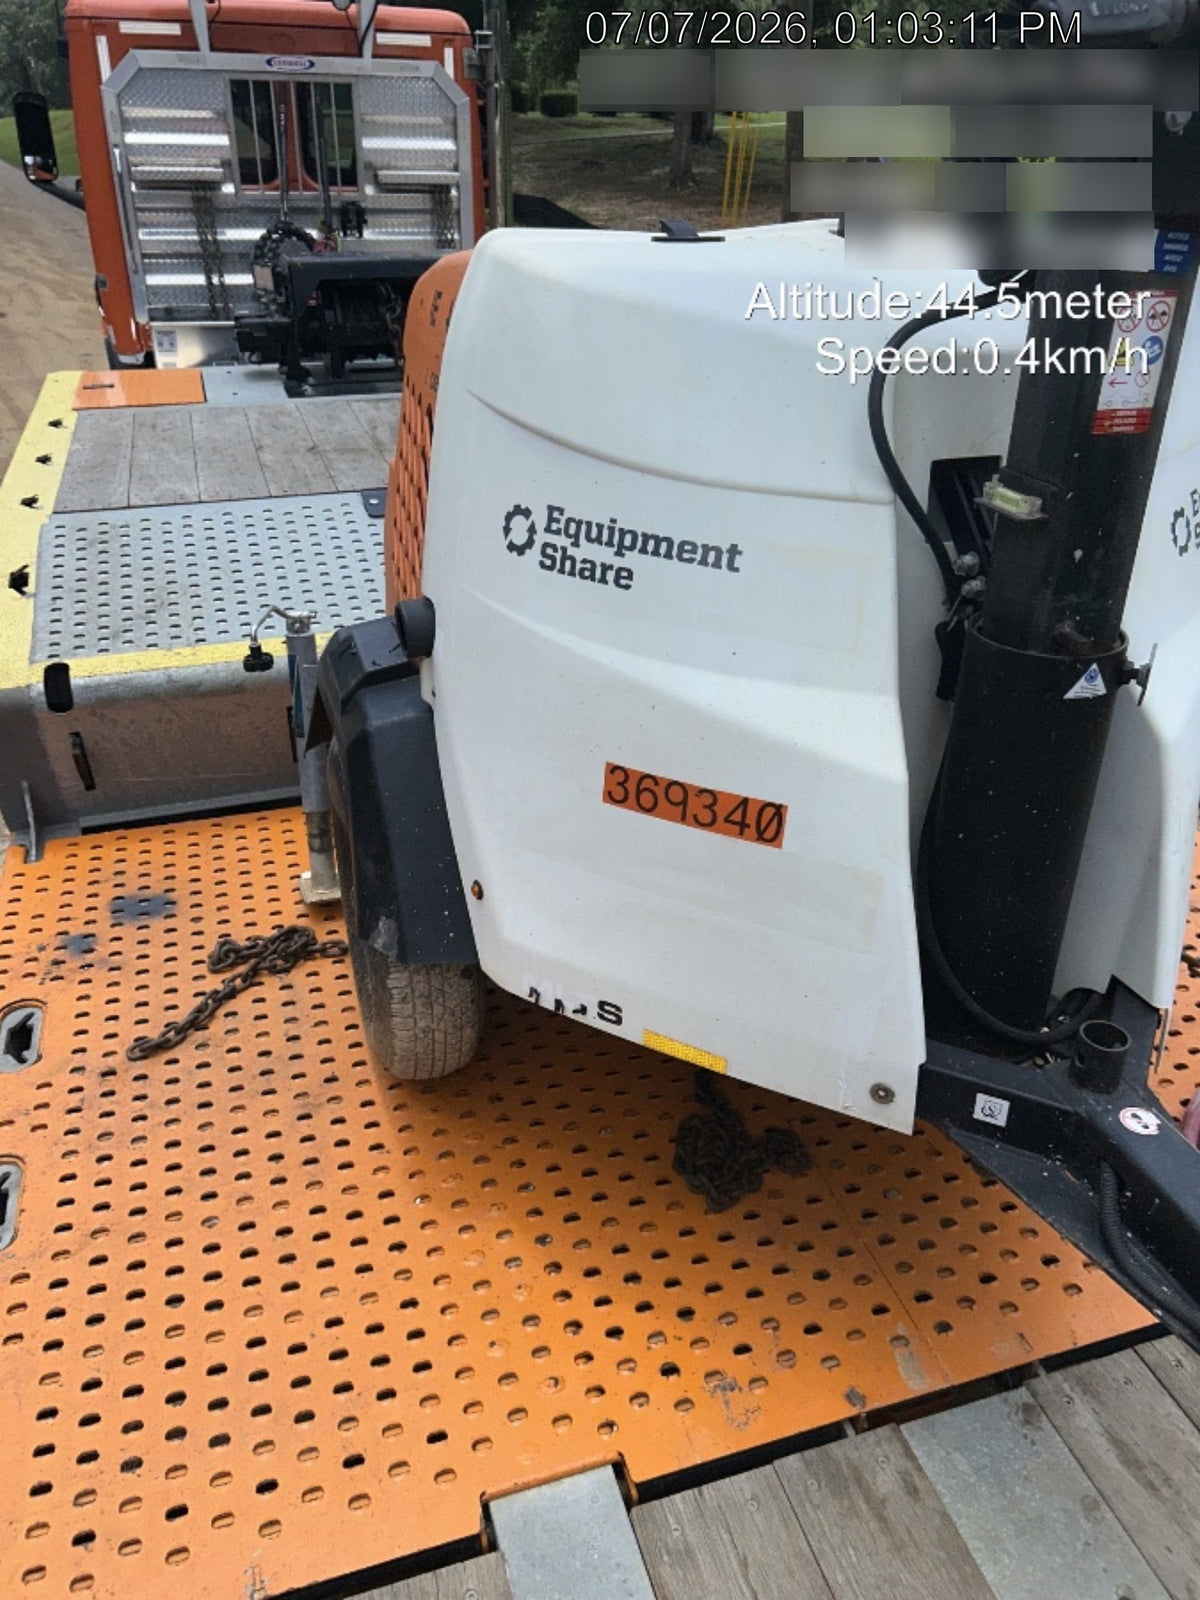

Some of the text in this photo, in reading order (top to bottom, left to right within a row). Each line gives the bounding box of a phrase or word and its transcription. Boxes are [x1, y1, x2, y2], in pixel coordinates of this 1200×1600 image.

[538, 542, 635, 591] Share
[543, 504, 743, 573] Equipment
[605, 764, 785, 845] 369340
